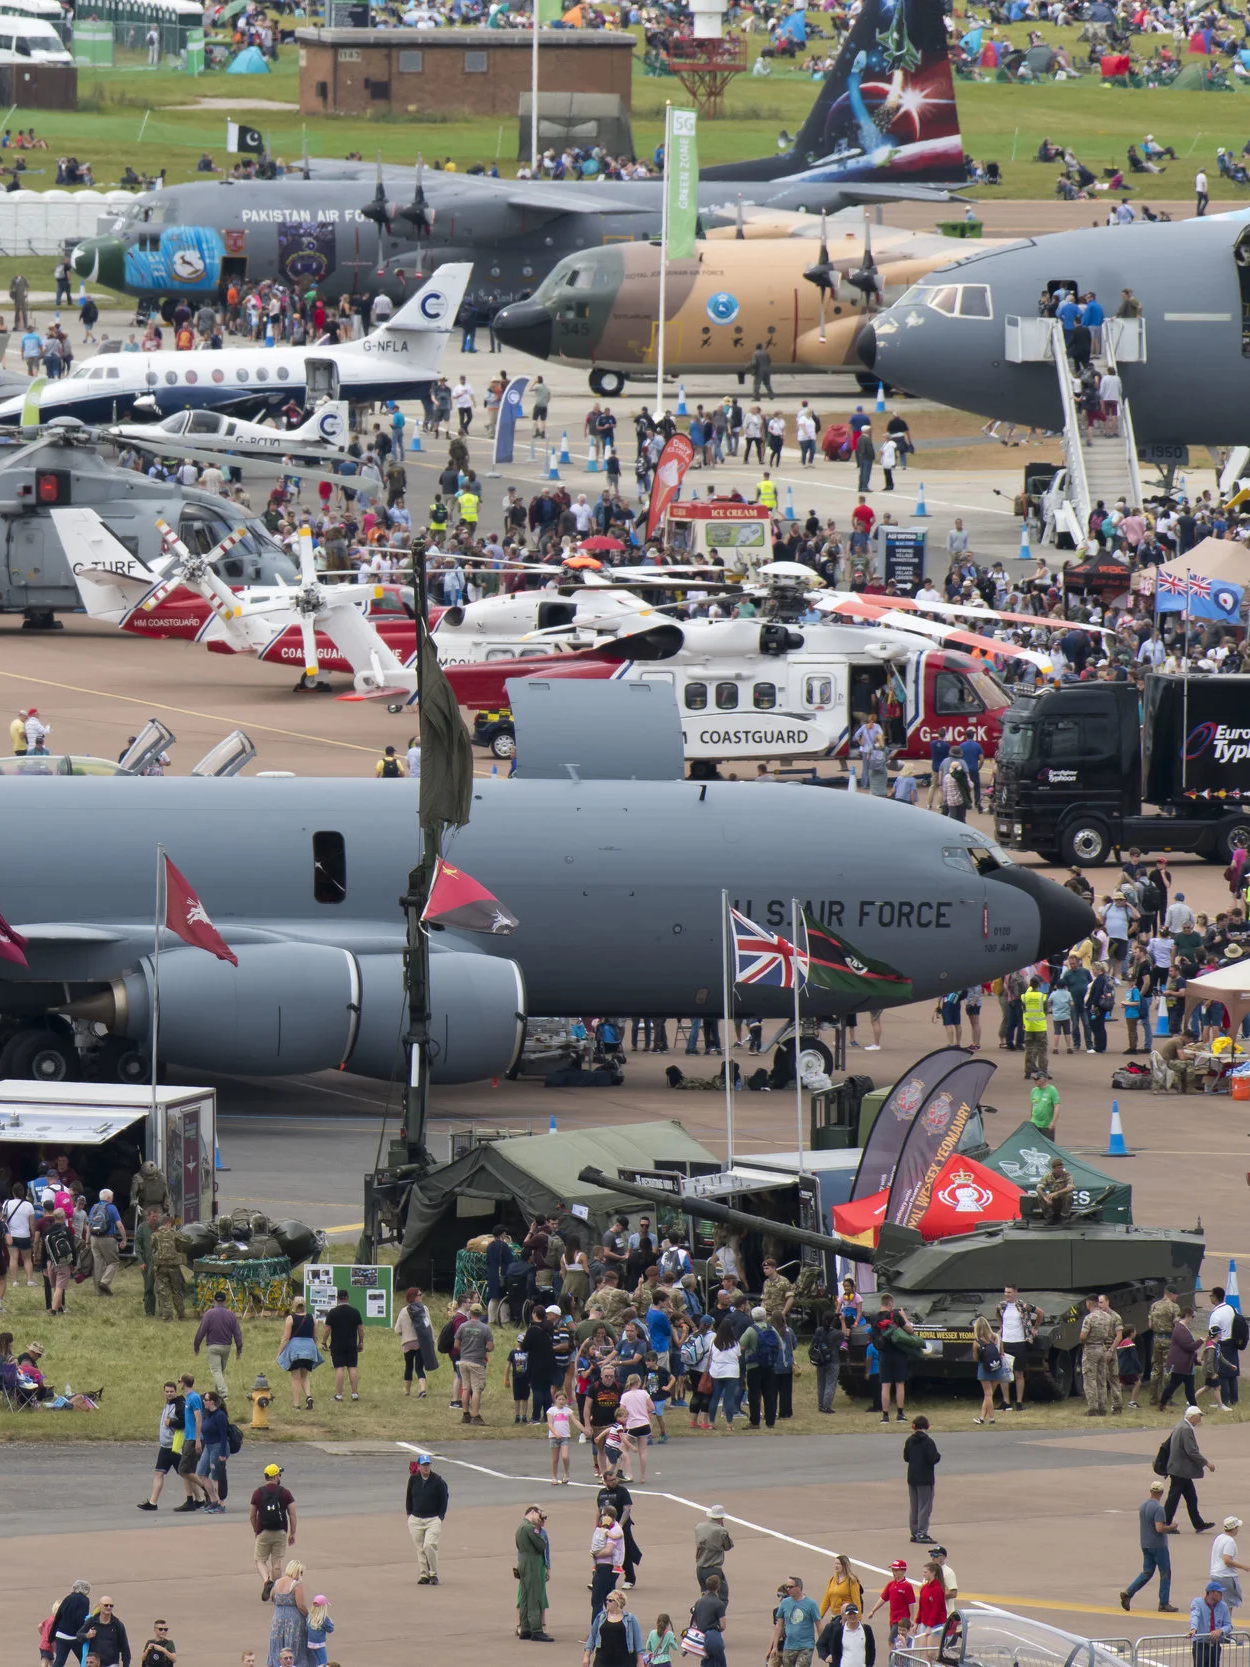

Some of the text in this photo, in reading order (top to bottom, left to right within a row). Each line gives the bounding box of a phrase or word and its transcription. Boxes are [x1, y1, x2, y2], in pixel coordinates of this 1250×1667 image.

[675, 116, 695, 130] 5G
[679, 138, 690, 209] GREEN ZONE
[242, 209, 311, 223] PAKISTAN
[317, 209, 340, 222] AIR
[561, 323, 590, 336] 345
[363, 340, 409, 353] G-NFLA
[1151, 446, 1183, 459] 1950
[711, 509, 758, 517] ICE CREAM
[134, 618, 200, 628] HM COASTGUARD
[700, 729, 809, 745] COASTGUARD
[1048, 775, 1077, 783] Typhoon
[858, 901, 953, 928] FORCE
[993, 926, 1011, 937] 0100
[999, 943, 1018, 952] ARW
[935, 1102, 971, 1161] YEOMANRY
[918, 1163, 942, 1208] WESSEX
